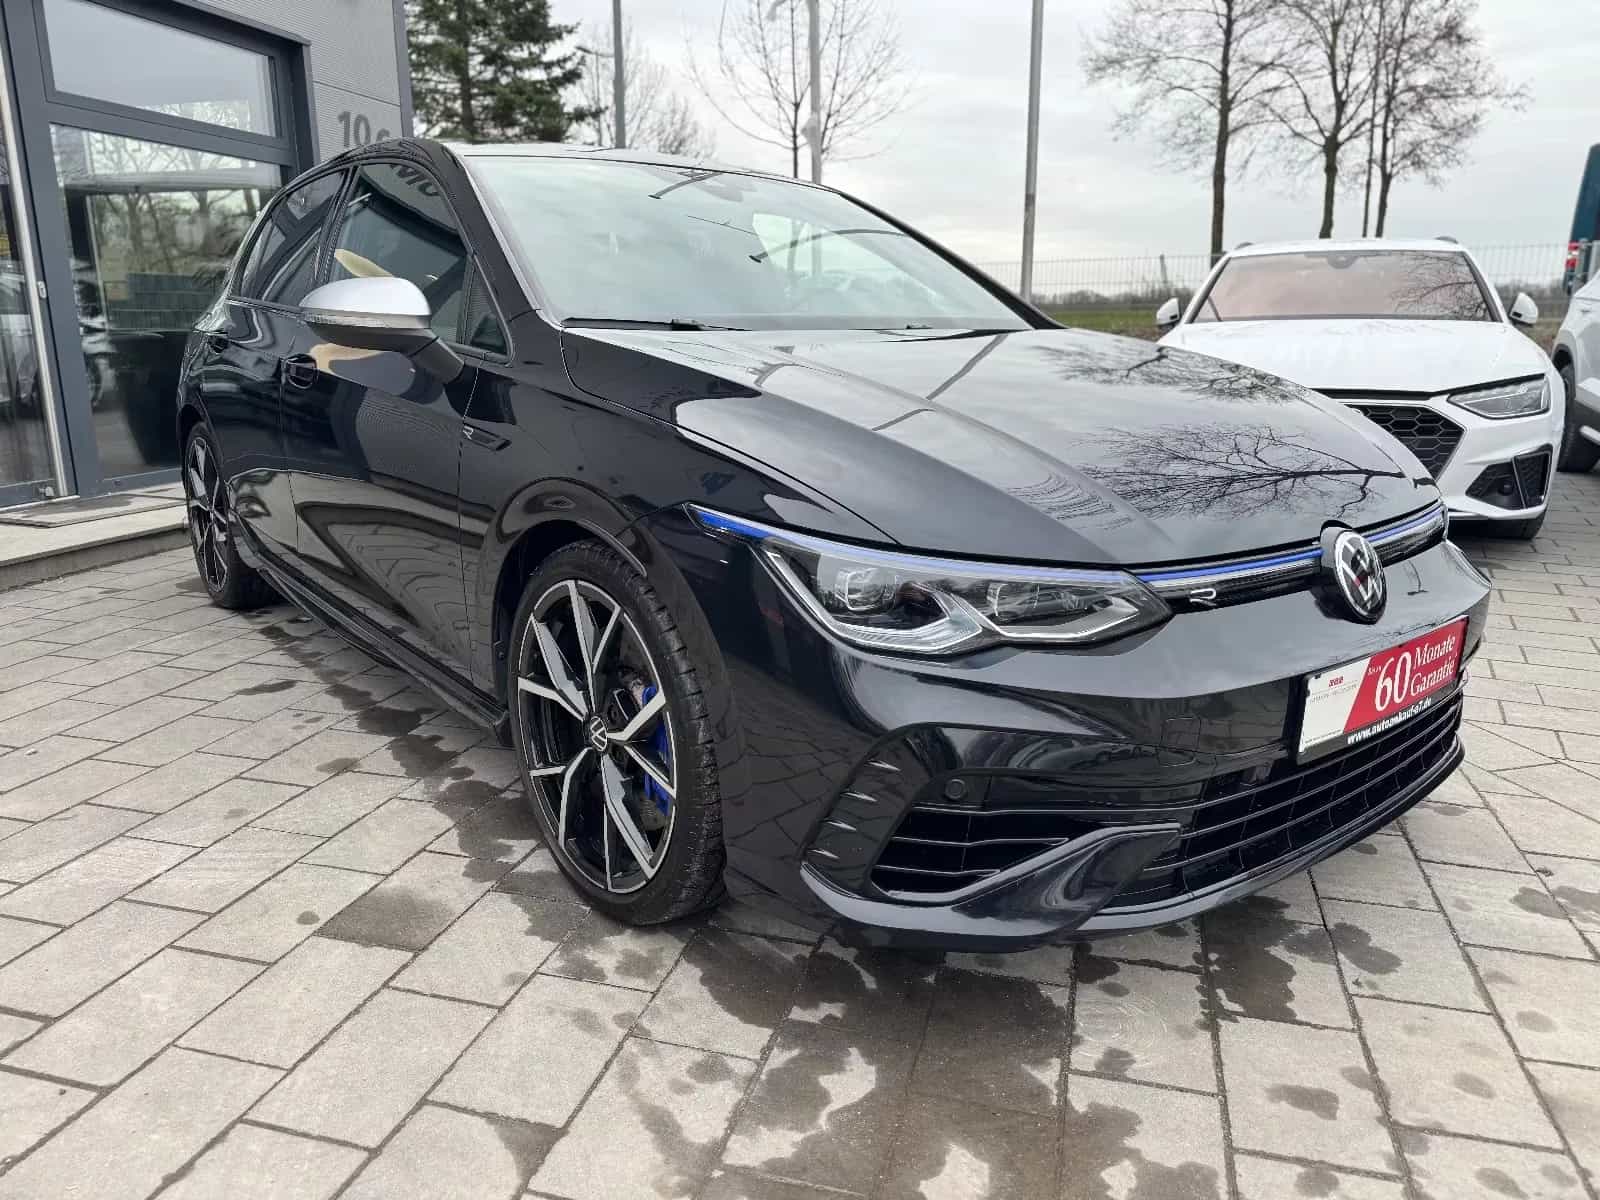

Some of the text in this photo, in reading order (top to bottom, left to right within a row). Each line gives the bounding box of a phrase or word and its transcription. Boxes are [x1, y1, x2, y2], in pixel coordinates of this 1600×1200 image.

[1374, 651, 1412, 712] 60
[1413, 634, 1456, 670] Monate
[1410, 655, 1456, 697] Garantie
